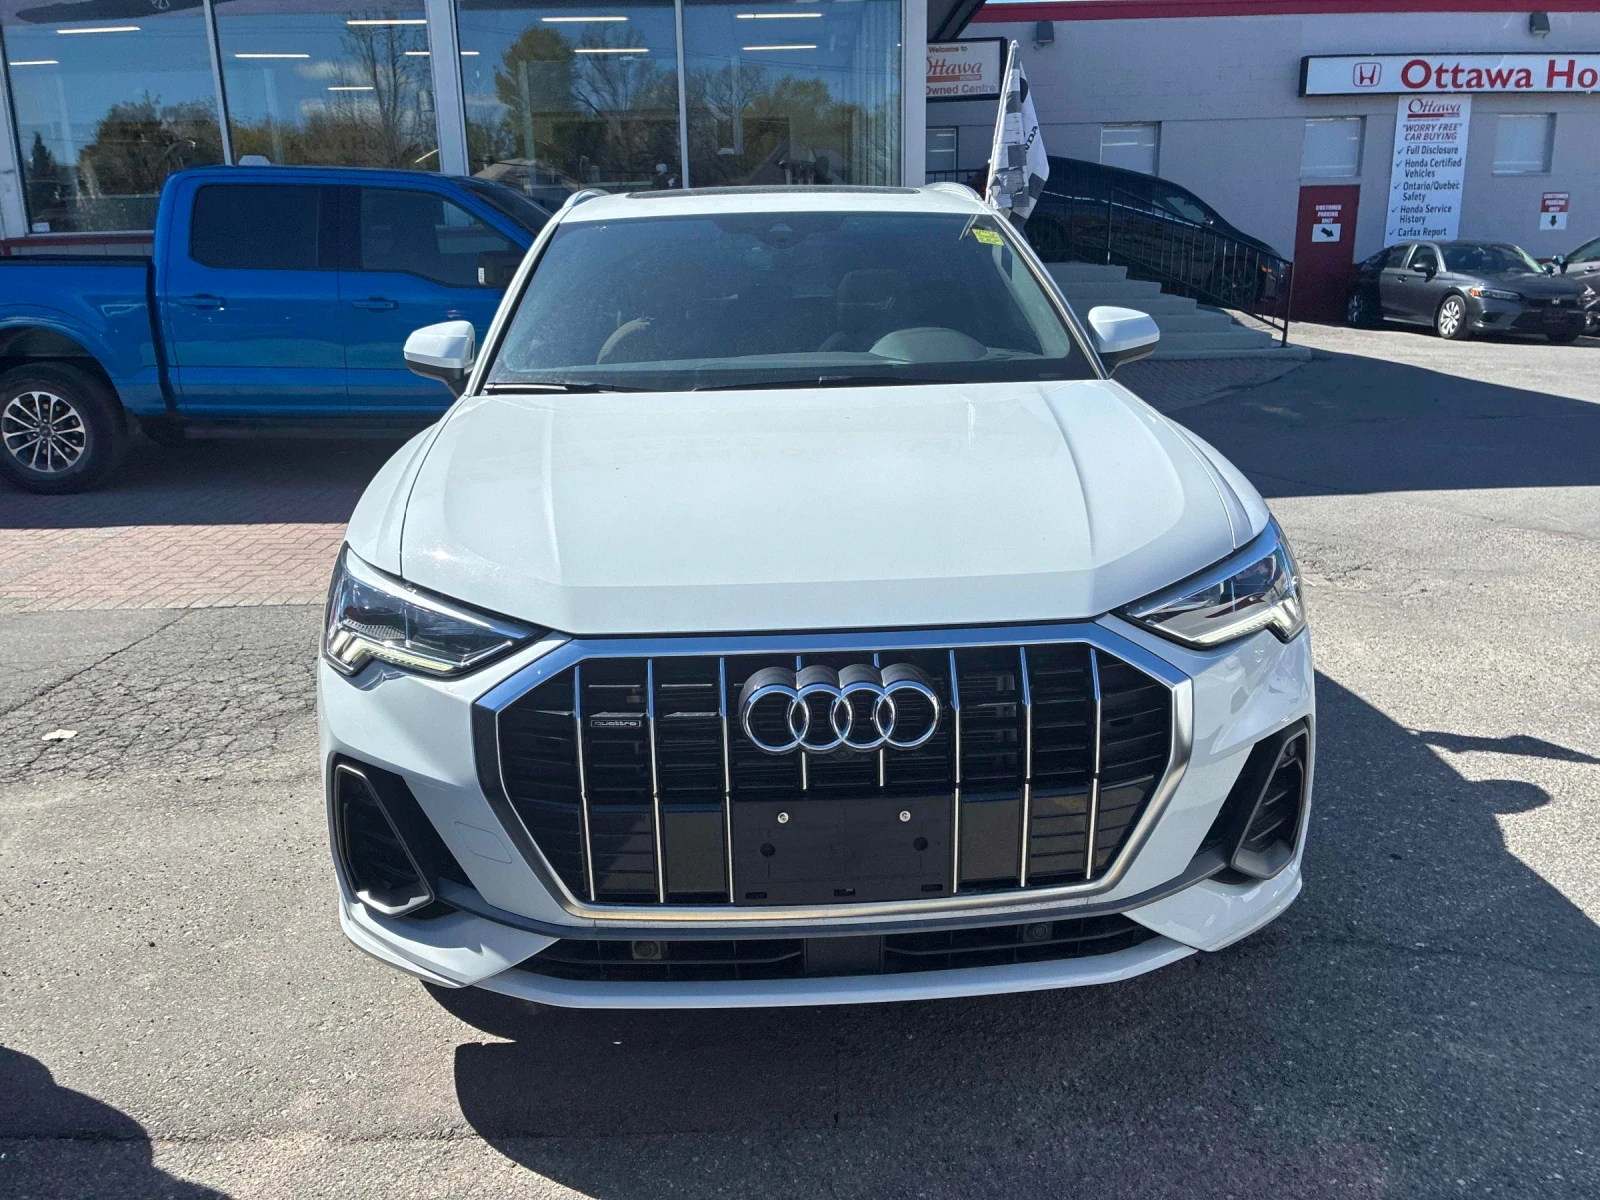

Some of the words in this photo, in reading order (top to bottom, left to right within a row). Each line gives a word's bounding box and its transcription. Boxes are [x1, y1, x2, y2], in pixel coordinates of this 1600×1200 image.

[928, 45, 960, 53] Welcome
[1400, 59, 1533, 89] Ottawa
[961, 83, 996, 94] Centre
[1408, 98, 1461, 113] Ottawa
[1404, 133, 1422, 141] CAR
[1423, 132, 1457, 141] BUYING
[1406, 145, 1420, 155] Full
[1421, 145, 1459, 154] Disclosure
[1405, 158, 1428, 168] Honda
[1430, 157, 1462, 167] Certified
[1405, 168, 1436, 178] Vehicles
[1403, 180, 1461, 191] Ontario/Quebec
[1402, 192, 1427, 203] Safety
[1400, 205, 1424, 214] Honda
[1425, 204, 1453, 213] Service
[1399, 215, 1427, 225] History
[1397, 227, 1421, 237] Carfax
[1422, 227, 1447, 238] Report
